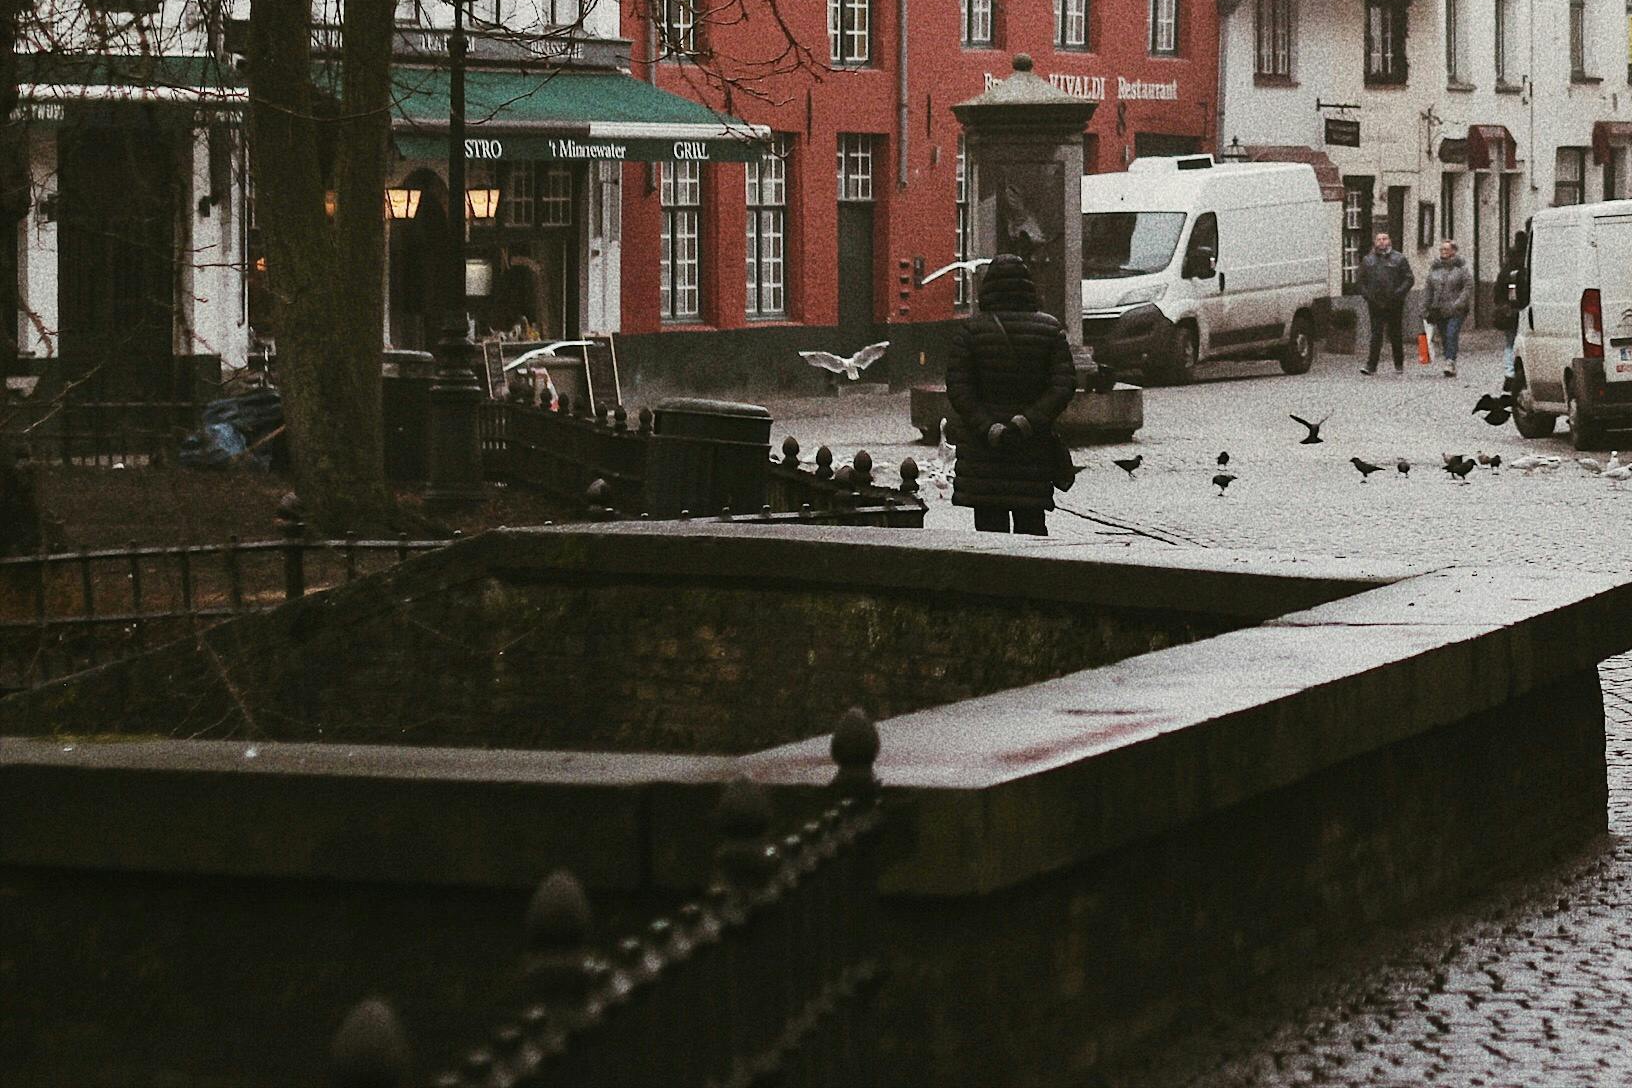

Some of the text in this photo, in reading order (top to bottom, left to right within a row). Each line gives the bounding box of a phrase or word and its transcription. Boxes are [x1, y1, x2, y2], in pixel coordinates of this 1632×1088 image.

[1117, 76, 1178, 100] Restaurant
[464, 139, 503, 159] STRO
[558, 140, 627, 159] Minnewater
[673, 141, 710, 160] GRILL
